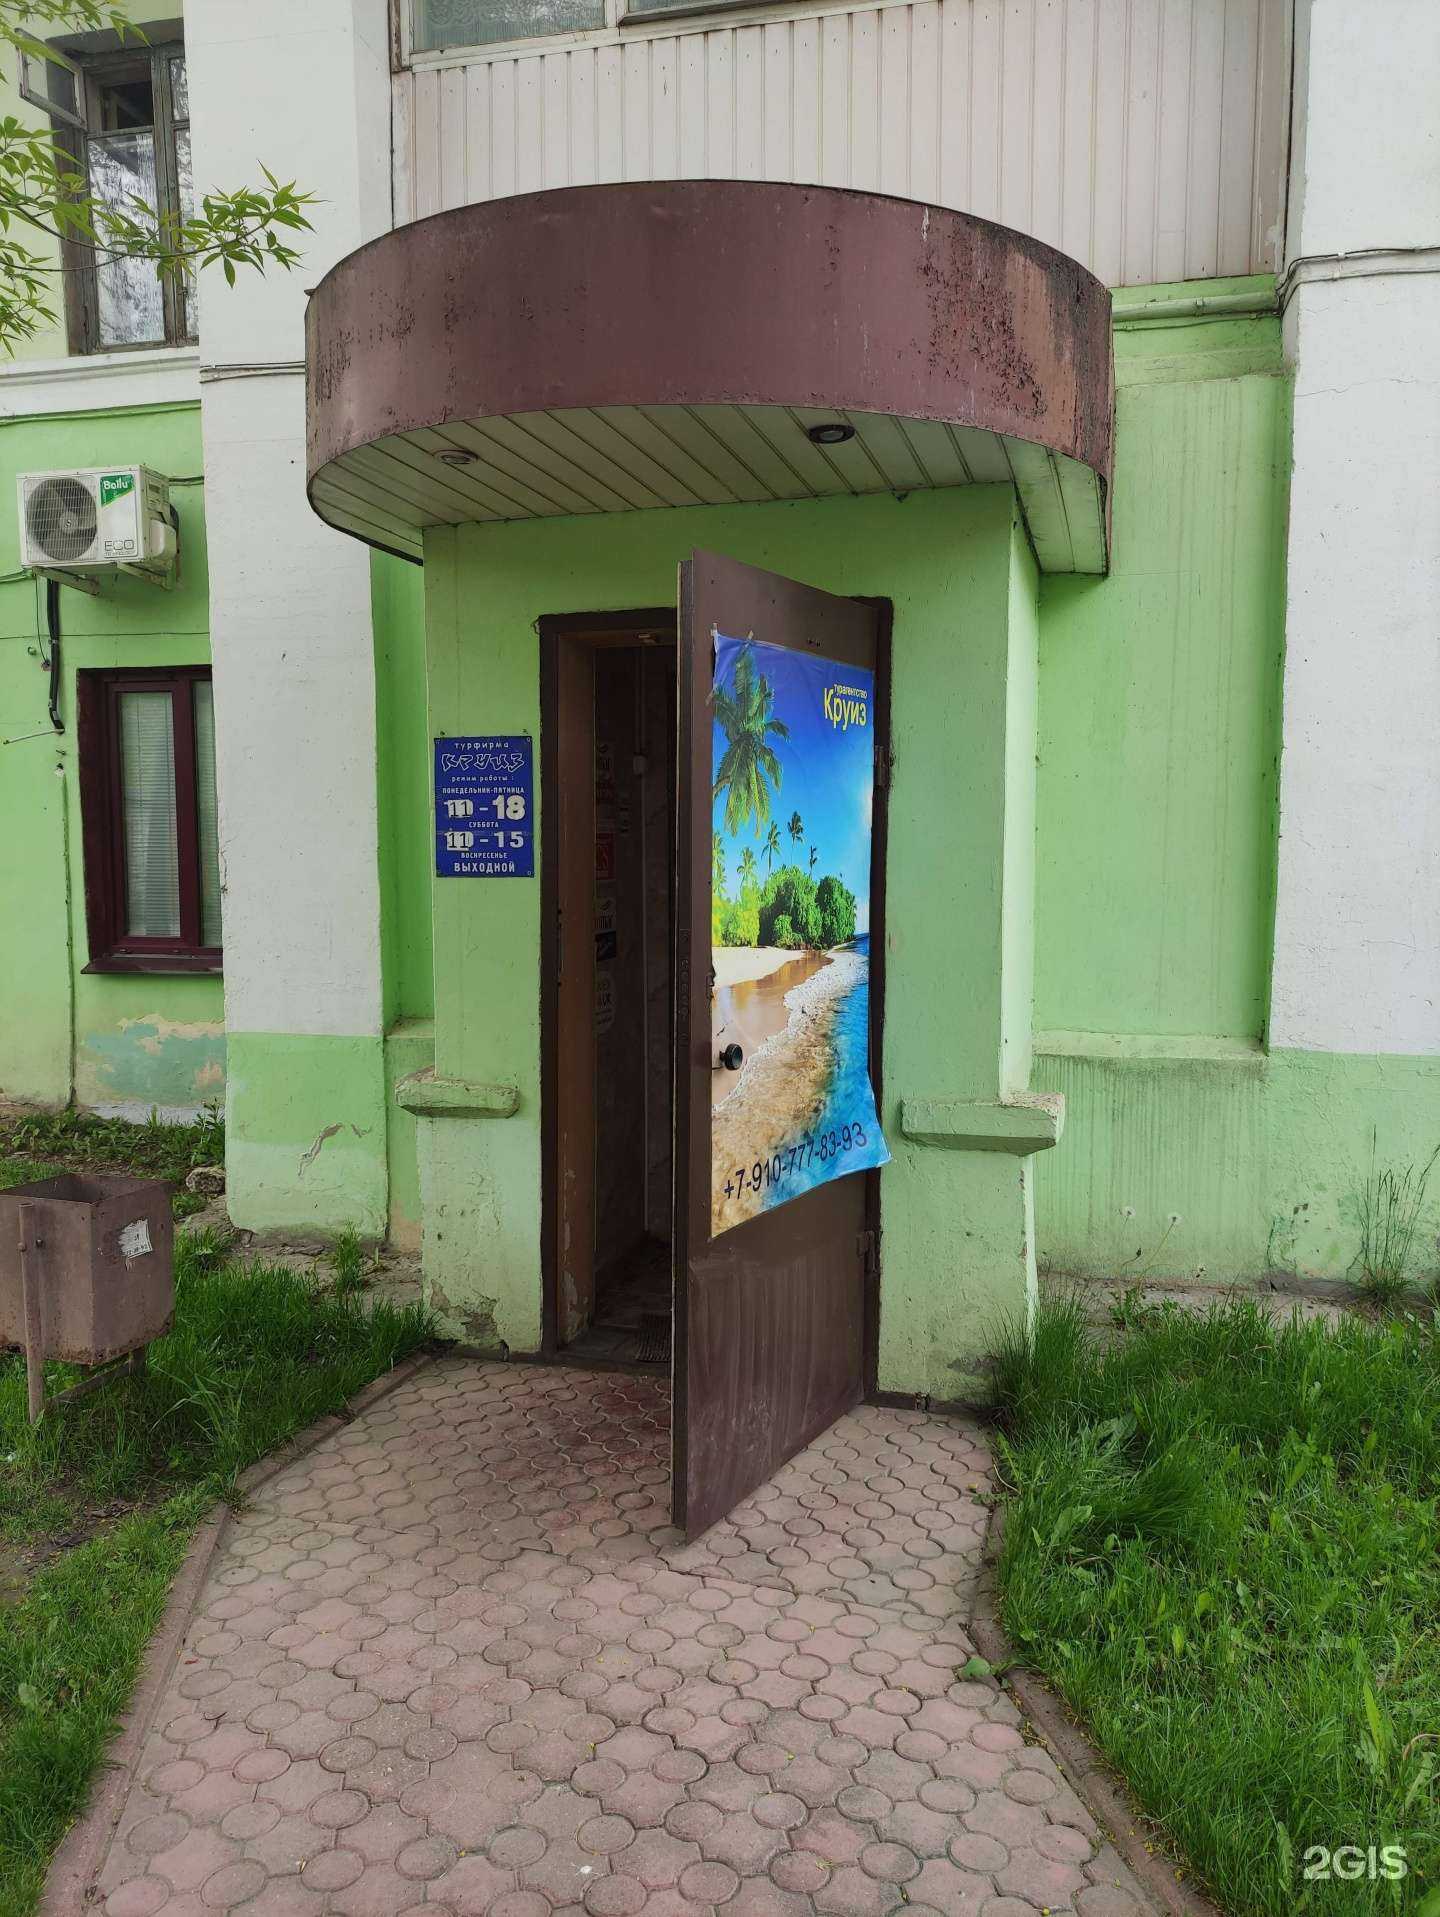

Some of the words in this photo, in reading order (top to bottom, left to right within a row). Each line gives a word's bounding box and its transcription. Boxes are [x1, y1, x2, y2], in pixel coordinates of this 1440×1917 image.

[824, 687, 867, 731] Круиз
[454, 742, 509, 750] турфирма
[492, 795, 526, 820] 18
[494, 831, 524, 848] 15
[454, 861, 515, 873] ВЫХОДНОЙ
[724, 1122, 867, 1199] +7-910-777-83-93
